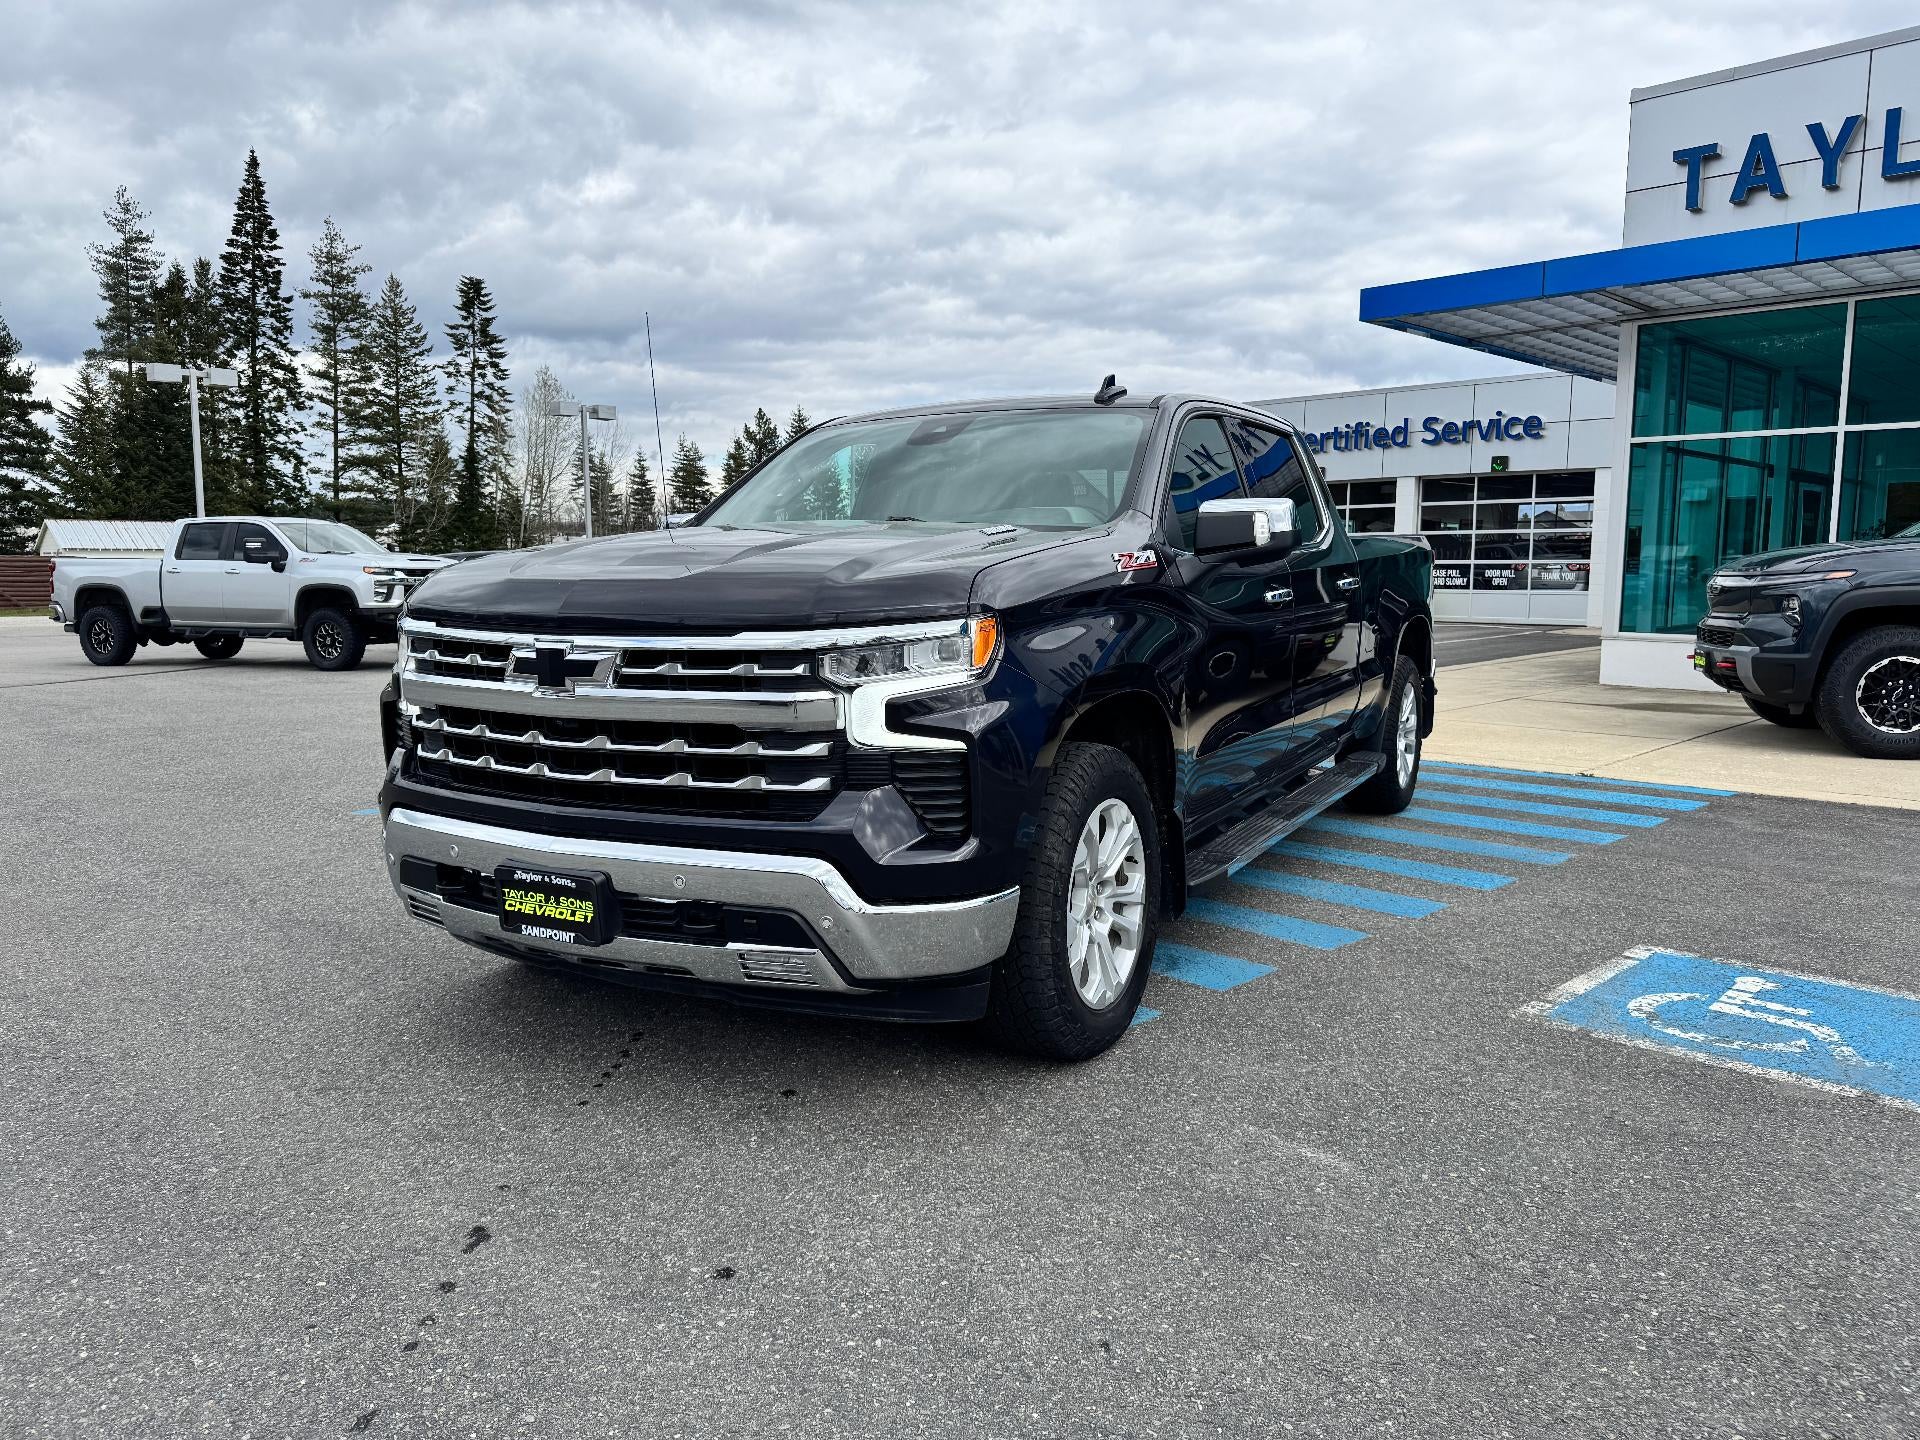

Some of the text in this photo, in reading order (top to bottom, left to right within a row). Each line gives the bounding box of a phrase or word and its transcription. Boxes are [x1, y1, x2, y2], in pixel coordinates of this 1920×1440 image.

[1304, 411, 1544, 452] ertified Service
[1111, 550, 1157, 572] Z71
[1433, 569, 1461, 578] EASE PULL
[1445, 577, 1467, 586] SLOWLY
[1485, 569, 1516, 578] DOOR WILL
[1492, 577, 1508, 586] OPEN
[1541, 572, 1576, 582] THANK YOU!
[515, 870, 542, 882] Taylor
[552, 875, 572, 887] Sons
[502, 888, 593, 911] TAYLOR & SONS
[504, 900, 594, 923] CHEVROLET
[521, 925, 575, 944] SANDPOINT
